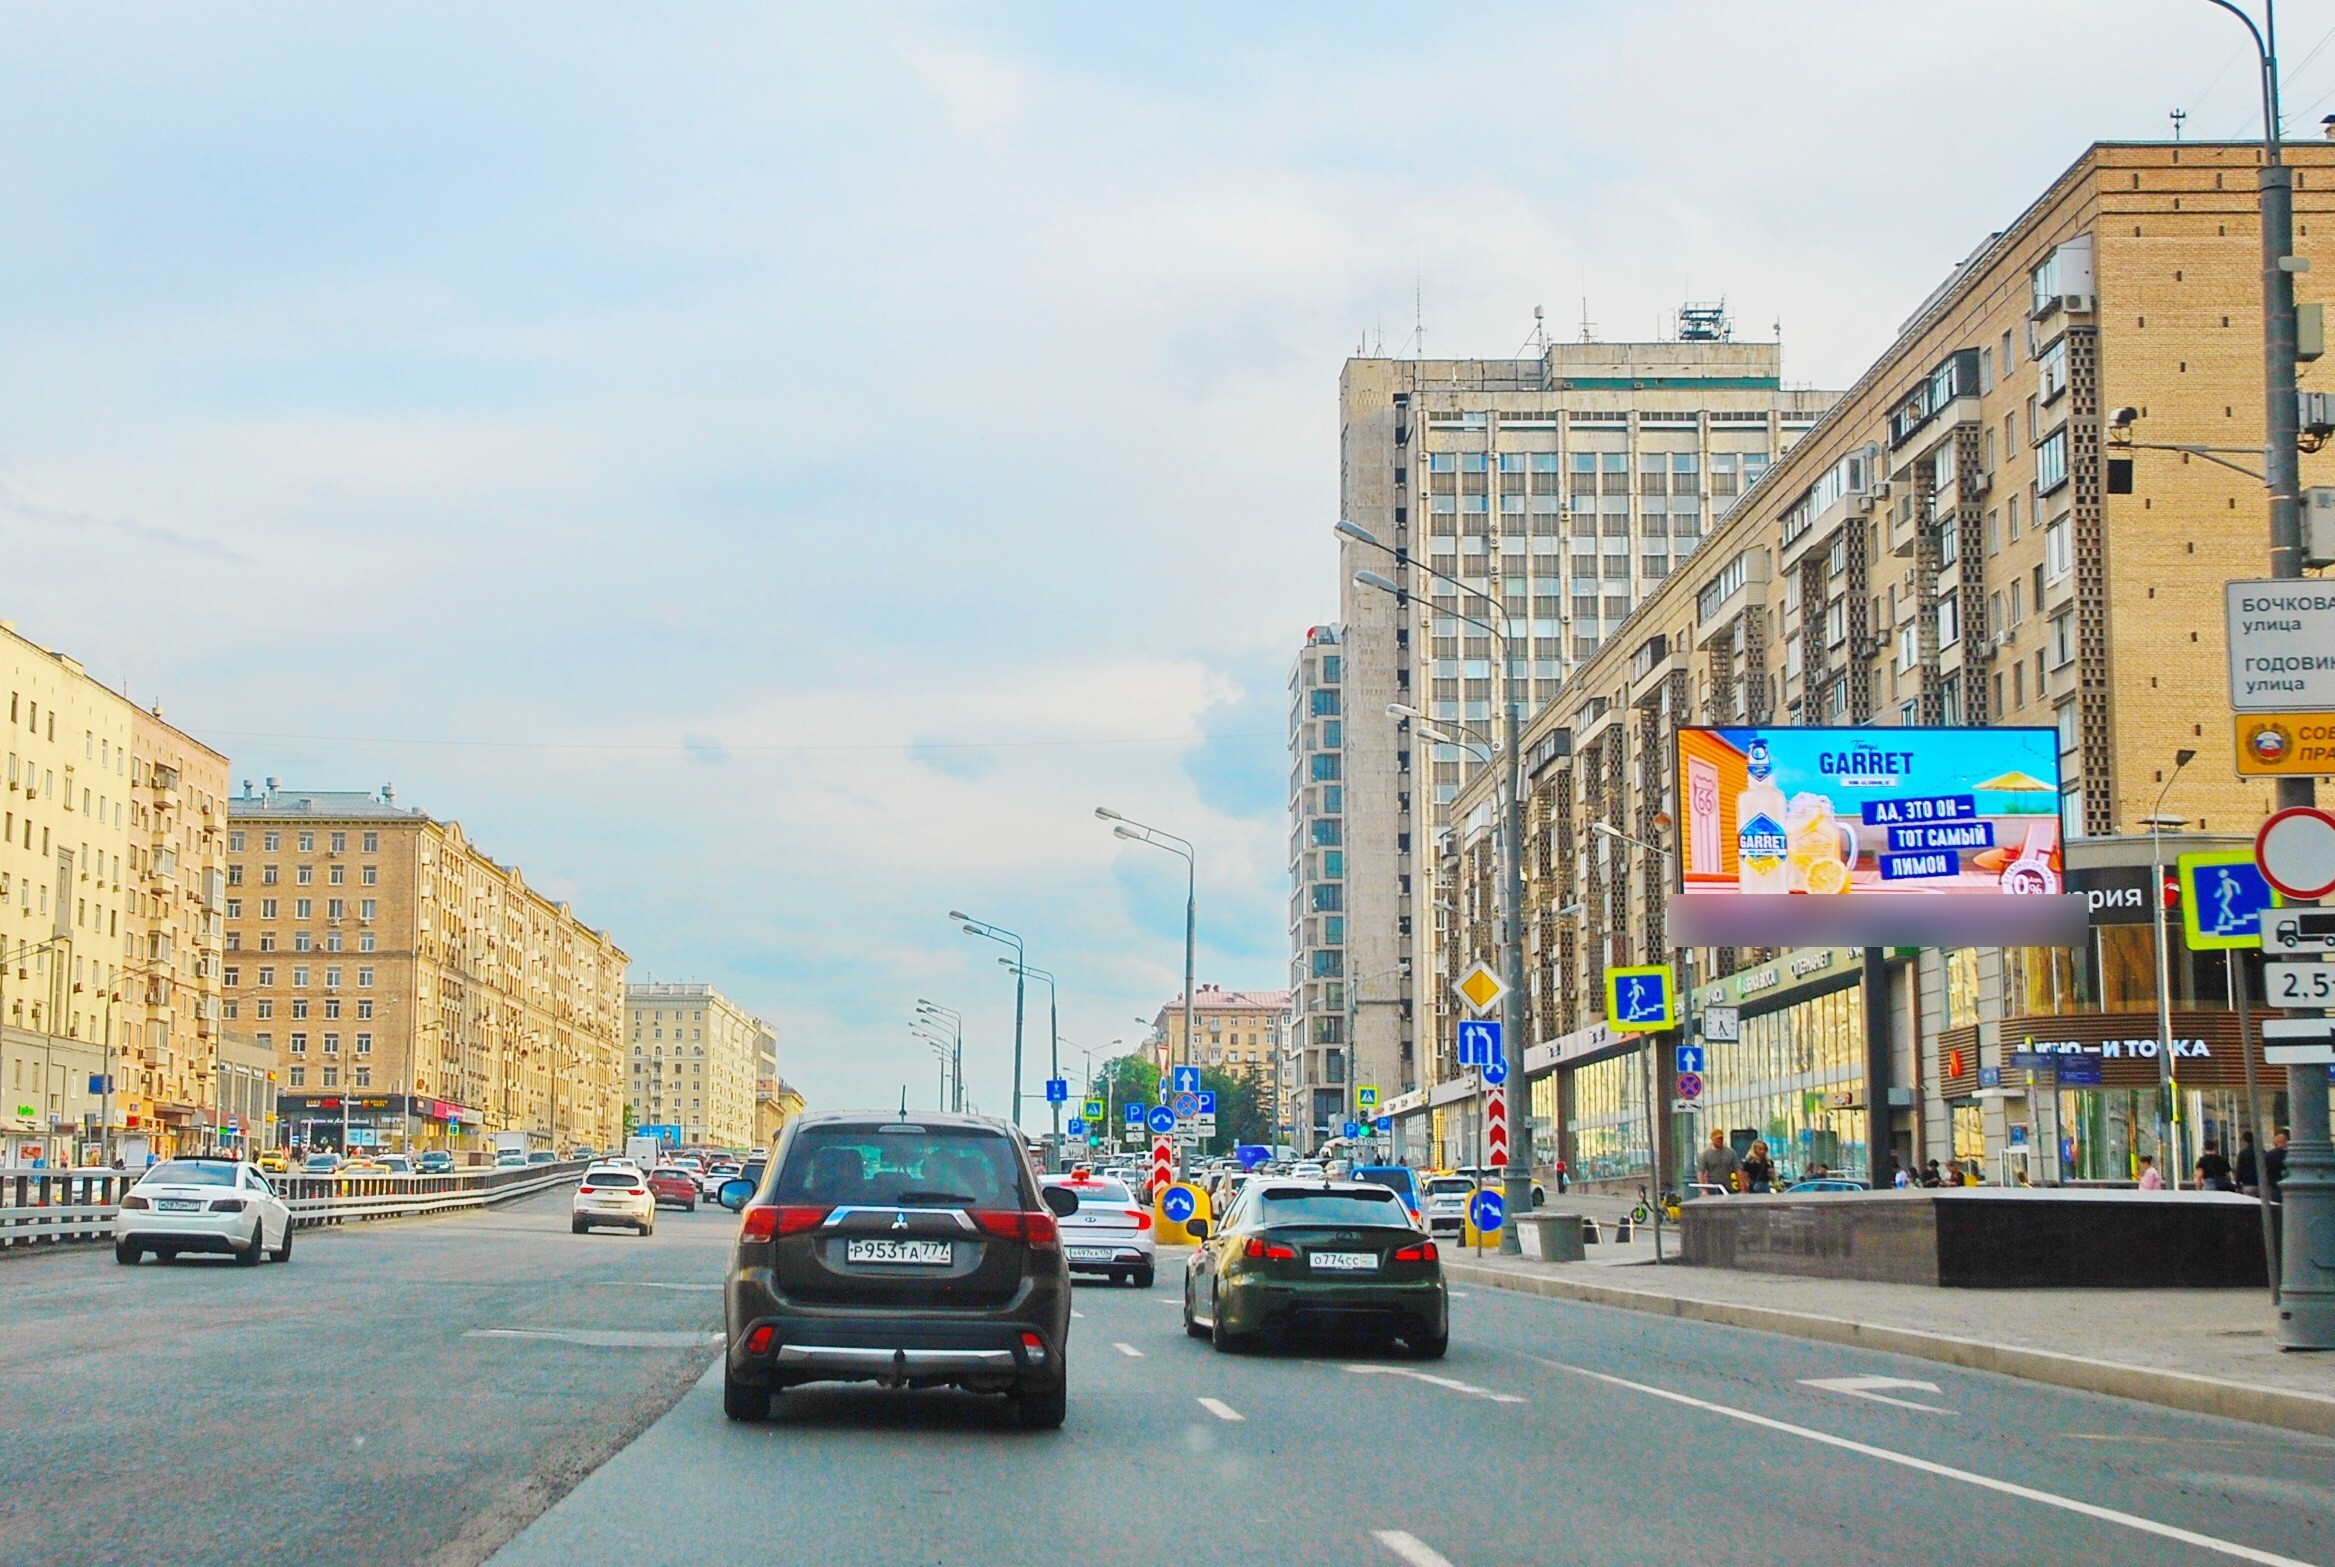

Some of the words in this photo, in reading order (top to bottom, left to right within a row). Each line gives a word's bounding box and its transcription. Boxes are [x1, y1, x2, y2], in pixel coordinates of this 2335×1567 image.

[2243, 619, 2301, 635] улица
[2246, 679, 2305, 694] улица
[1819, 752, 1914, 775] GARRET
[1905, 800, 1933, 819] ЭТО
[1740, 834, 1786, 849] GARRET
[1896, 829, 1923, 848] ТОТ
[1927, 824, 1987, 847] САМЫЙ
[1892, 854, 1947, 876] ЛИМОН
[2283, 972, 2335, 1000] 2,5
[2102, 1041, 2120, 1058] И
[2123, 1039, 2211, 1058] ТОКА
